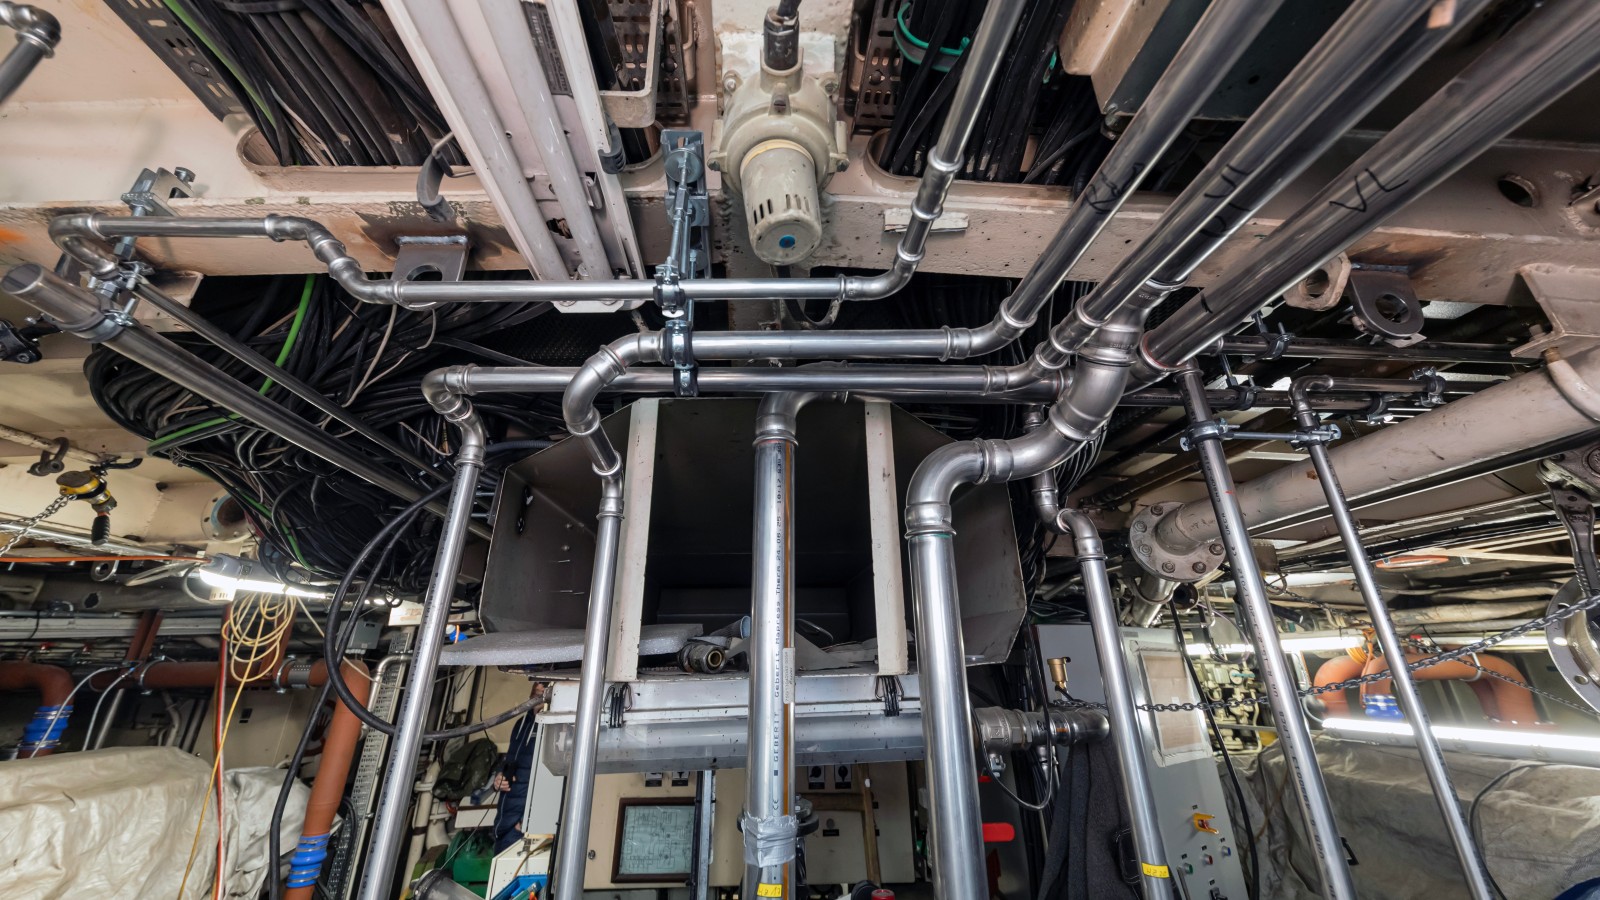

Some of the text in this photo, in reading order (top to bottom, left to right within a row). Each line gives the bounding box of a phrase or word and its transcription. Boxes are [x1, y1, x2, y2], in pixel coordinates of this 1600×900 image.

[1329, 168, 1409, 212] VL
[1220, 511, 1230, 535] UKCA
[1278, 710, 1290, 739] LPCB
